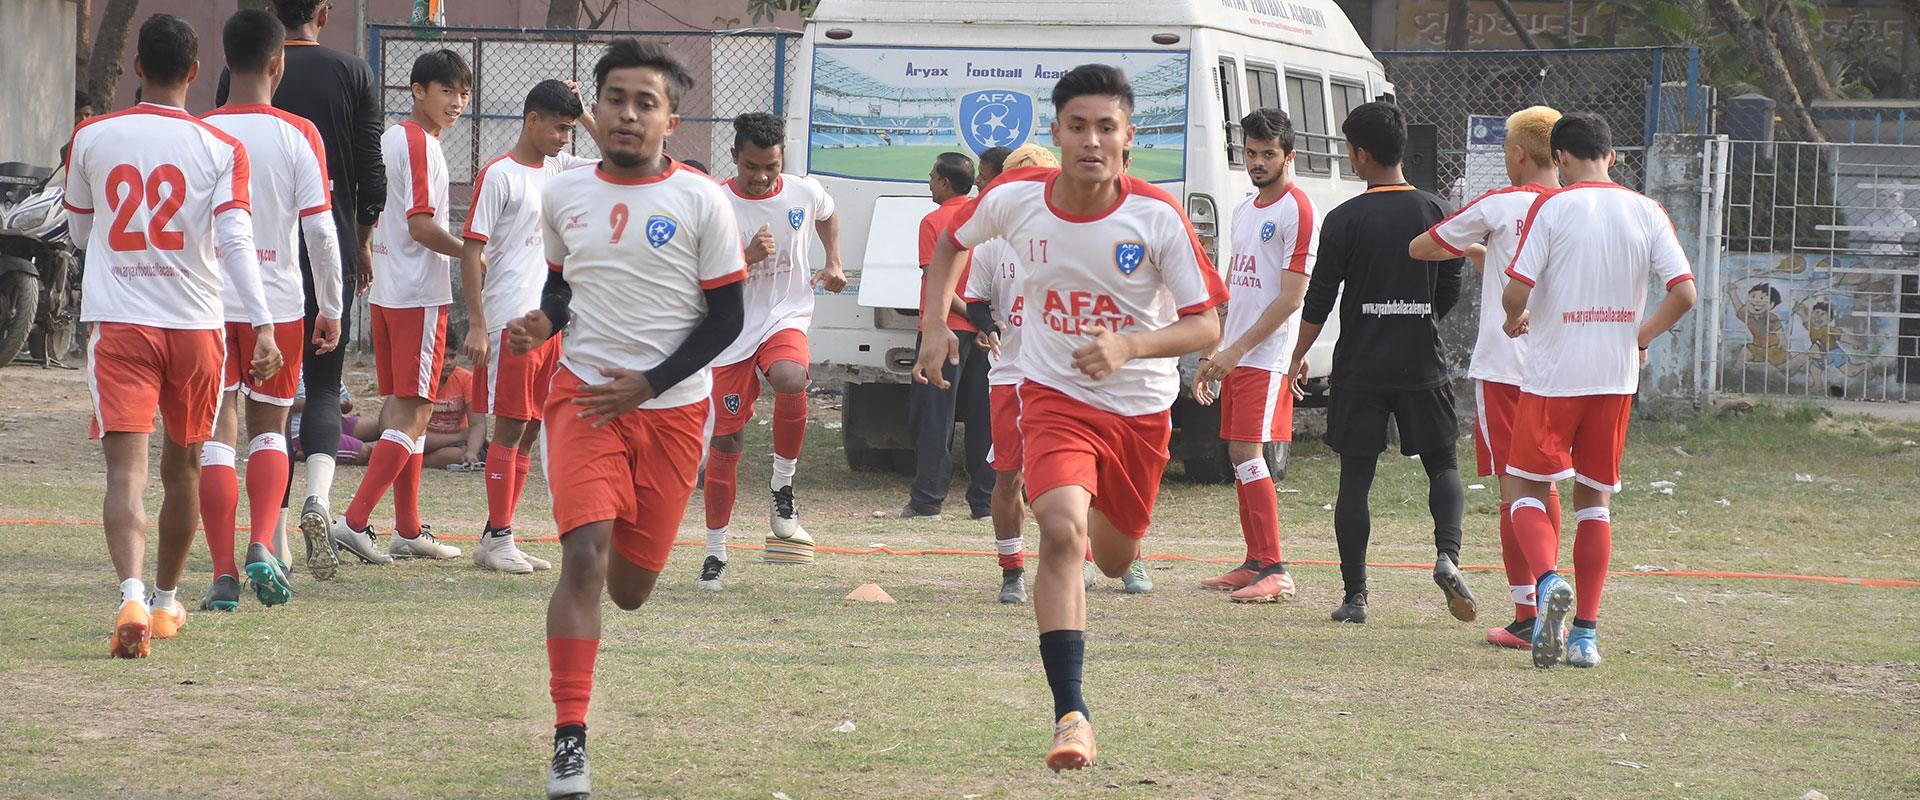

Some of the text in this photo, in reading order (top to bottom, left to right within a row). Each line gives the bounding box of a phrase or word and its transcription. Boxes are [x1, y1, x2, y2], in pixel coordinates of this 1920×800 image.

[1250, 0, 1290, 20] FOOTBALL
[1288, 3, 1327, 29] ACADEMY
[905, 62, 1070, 80] Aryax Football Acad
[975, 93, 1017, 103] AFA
[105, 163, 187, 252] 22
[608, 202, 629, 244] 9
[1515, 219, 1524, 236] R
[1029, 239, 1048, 264] 17
[1001, 262, 1015, 279] 19
[1044, 290, 1121, 316] AFA
